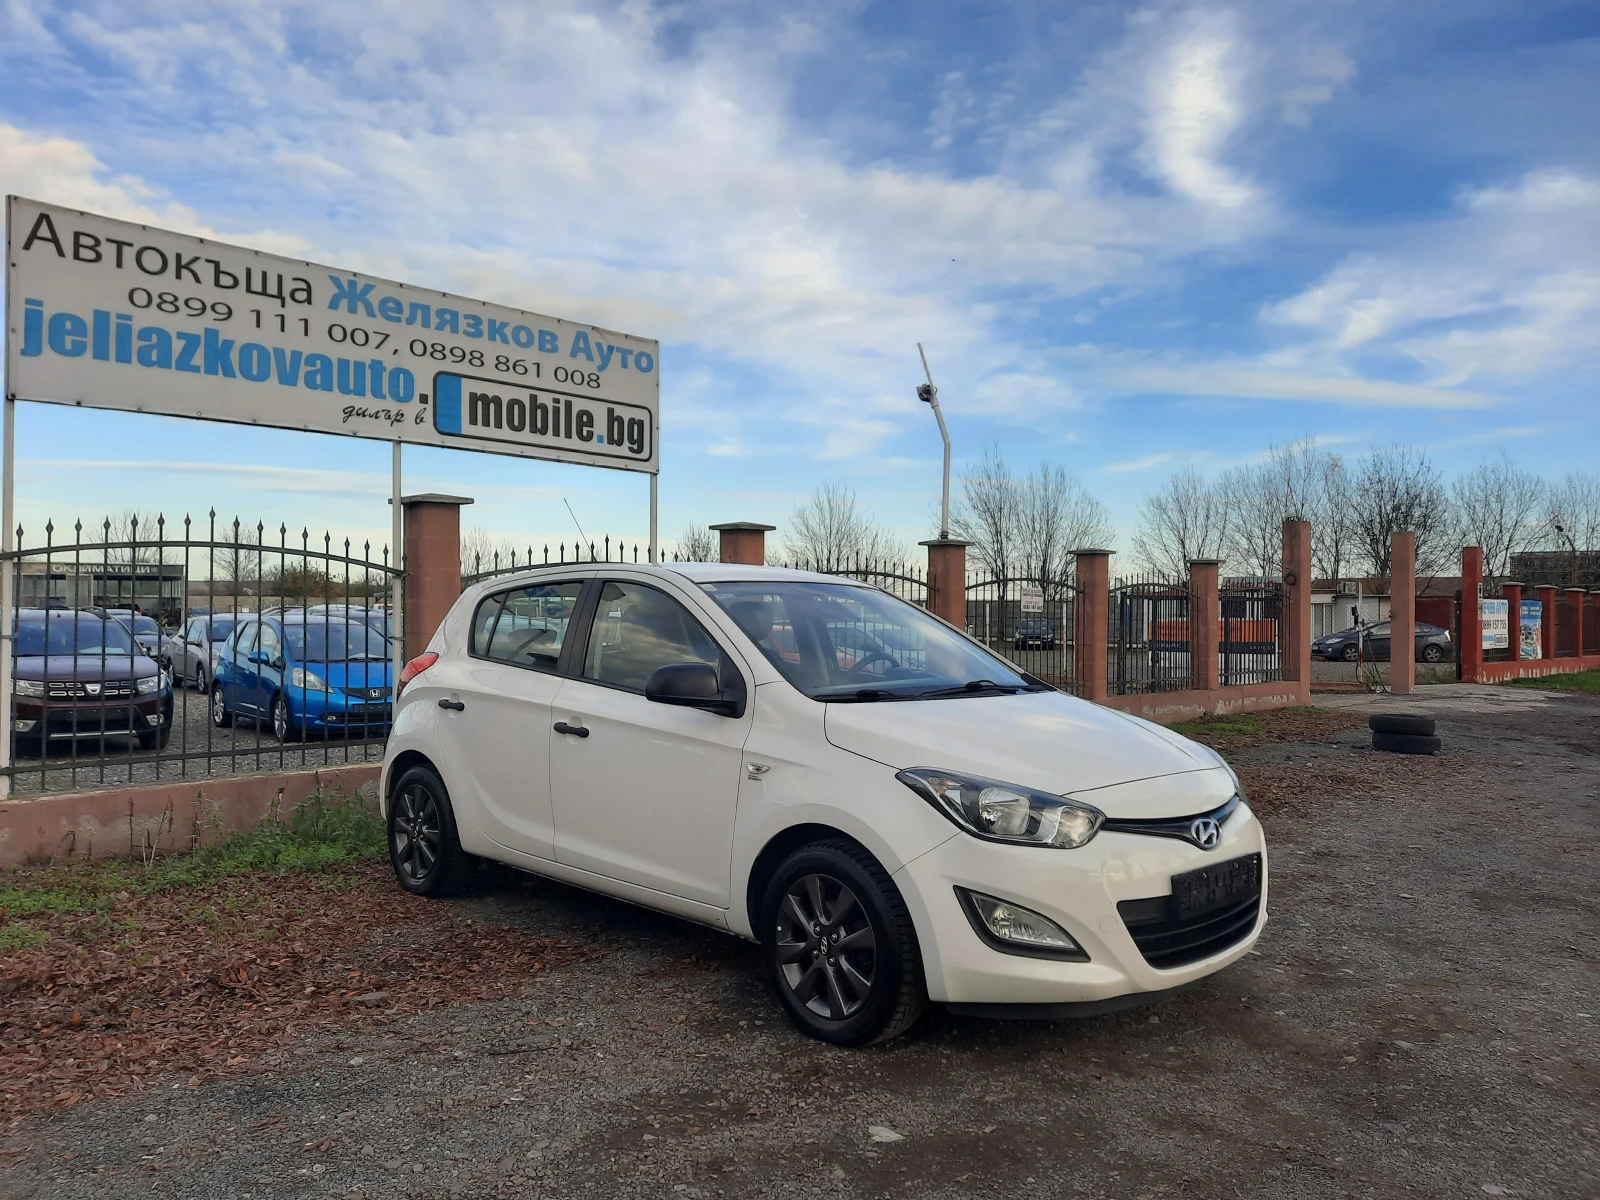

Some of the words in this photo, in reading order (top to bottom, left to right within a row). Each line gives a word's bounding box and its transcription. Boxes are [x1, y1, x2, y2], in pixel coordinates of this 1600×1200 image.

[22, 212, 312, 308] Автокъща
[328, 274, 559, 354] Желязков
[569, 329, 654, 373] Ауто
[128, 286, 233, 322] 0899
[250, 309, 309, 337] 111
[327, 323, 399, 355] 007,
[409, 338, 485, 368] 0898
[494, 354, 541, 379] 861
[554, 366, 601, 389] 008
[342, 405, 405, 428] дилър
[468, 391, 645, 455] mobile.bg
